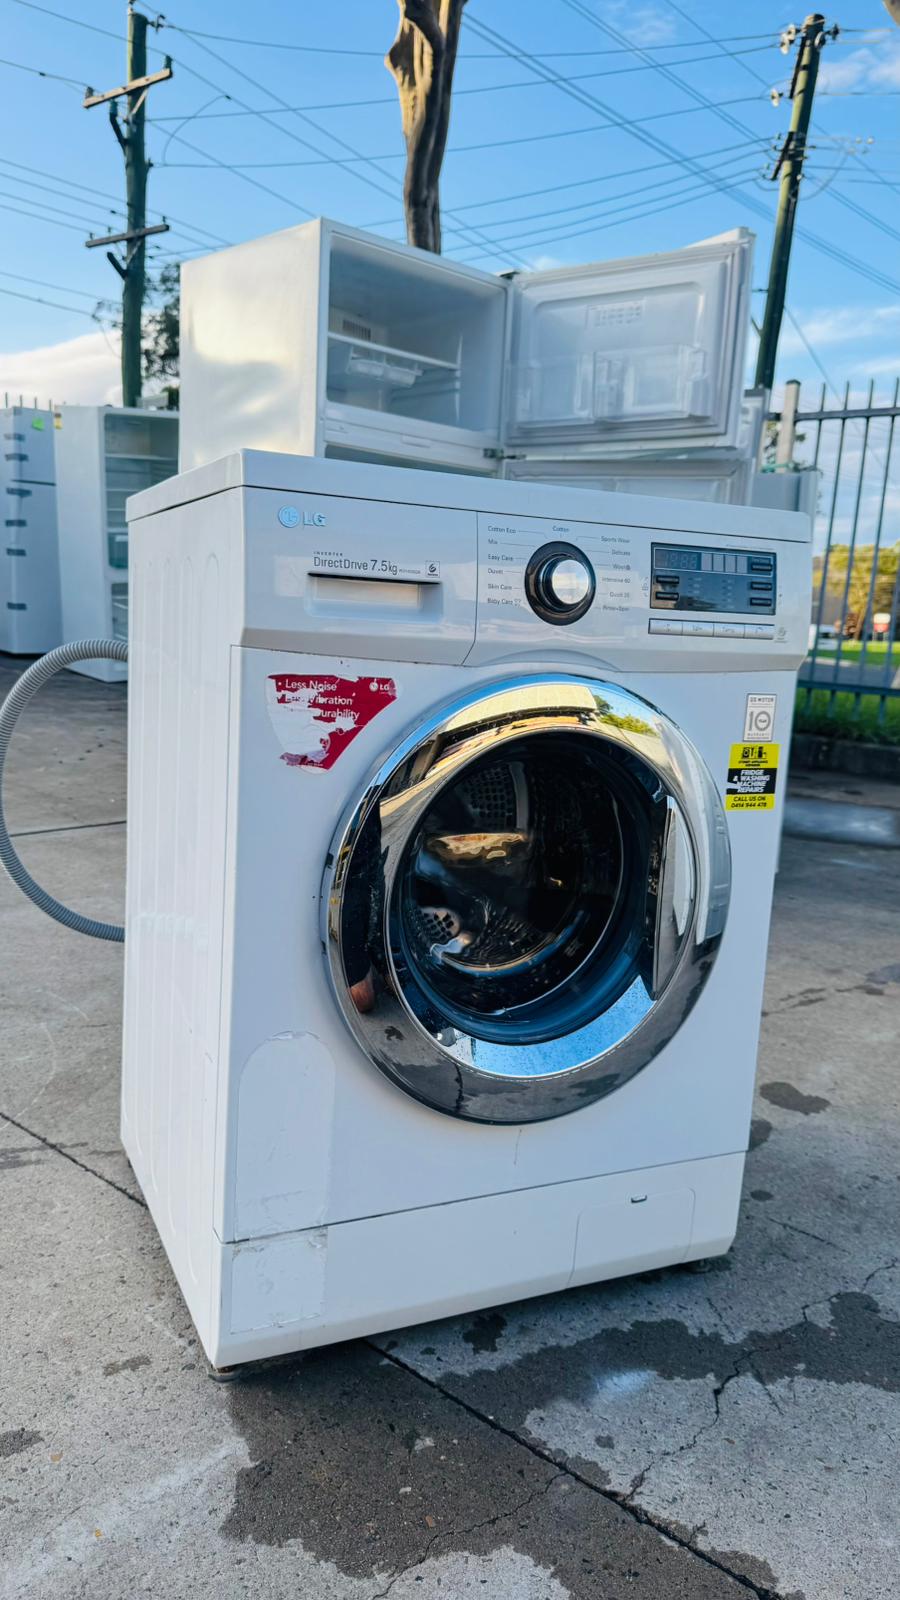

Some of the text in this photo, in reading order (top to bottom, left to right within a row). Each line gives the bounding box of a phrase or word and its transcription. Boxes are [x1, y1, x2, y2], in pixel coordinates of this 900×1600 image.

[303, 511, 327, 527] LG
[285, 679, 338, 691] Less Noise
[320, 708, 360, 721] urability
